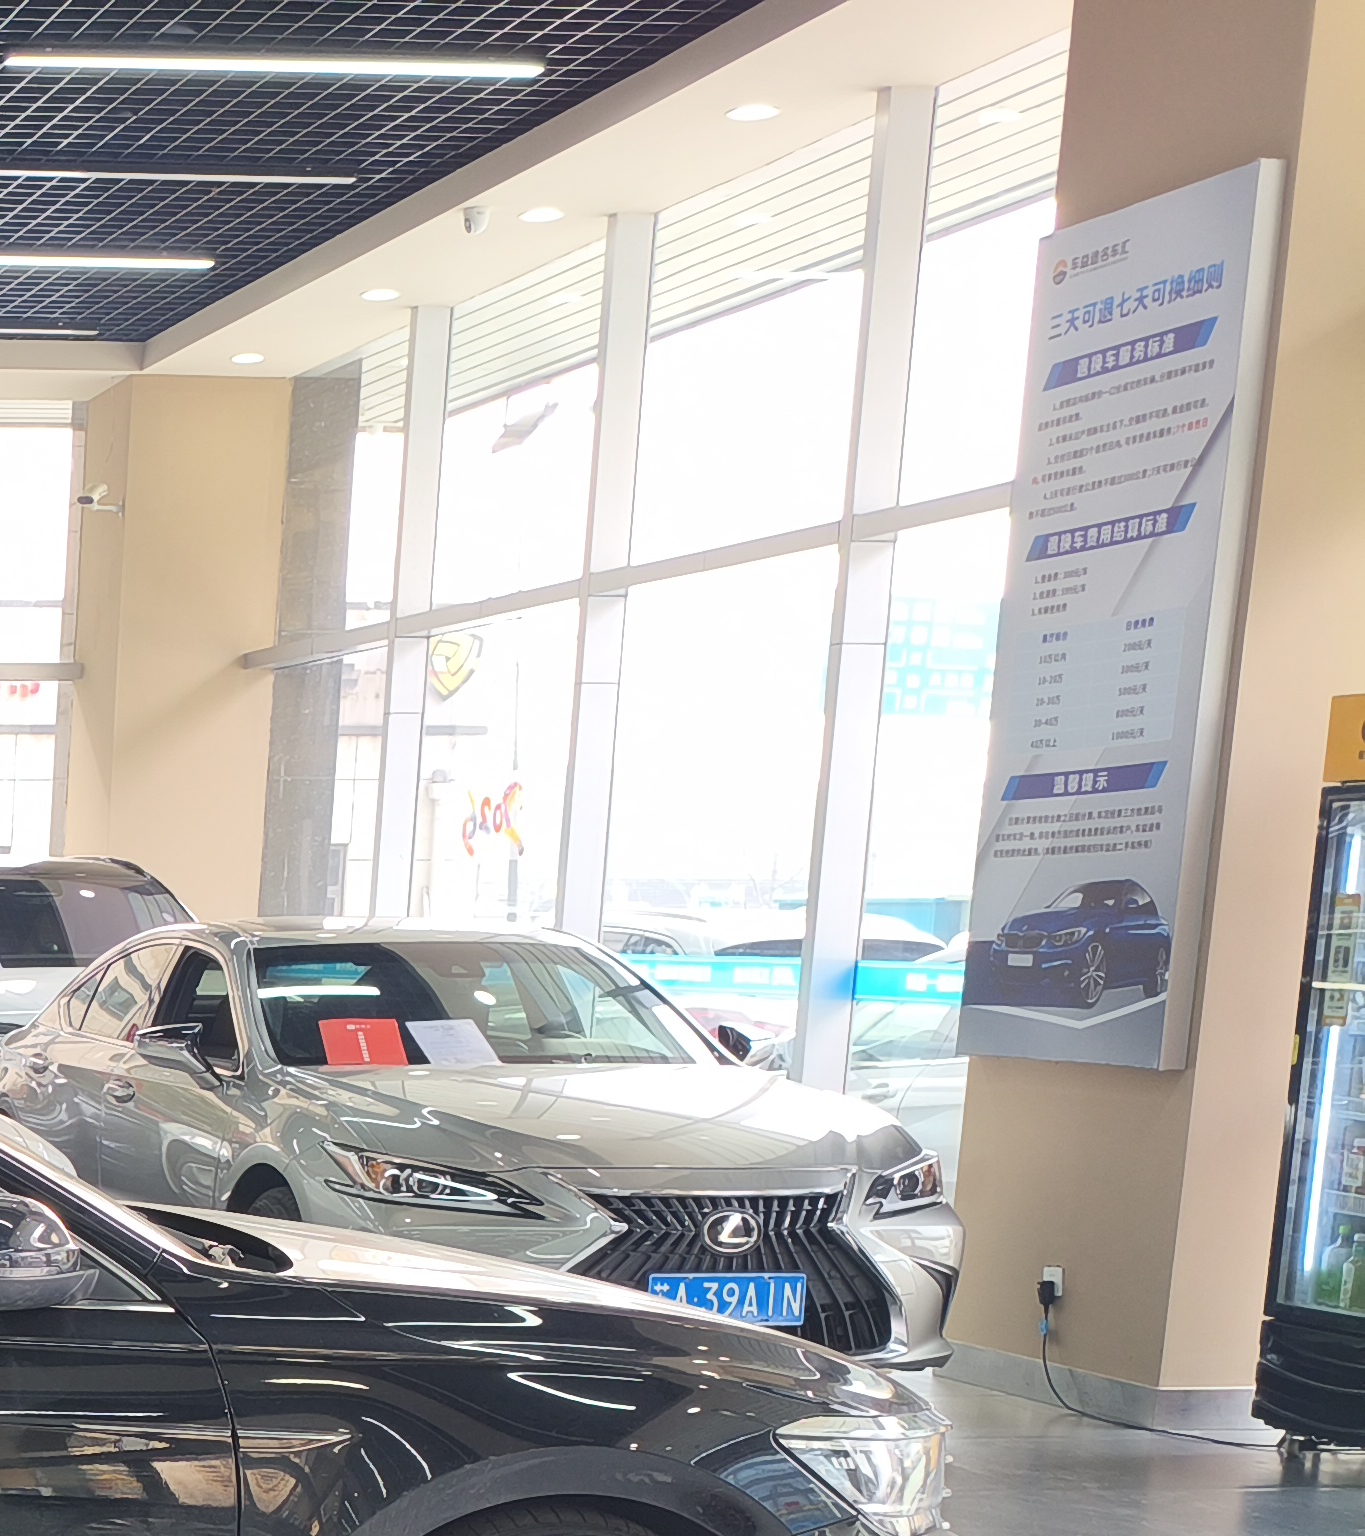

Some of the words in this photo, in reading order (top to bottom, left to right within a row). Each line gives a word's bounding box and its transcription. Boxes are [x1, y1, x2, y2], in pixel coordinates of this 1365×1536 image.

[1048, 260, 1225, 340] 三天可退七天可换细则
